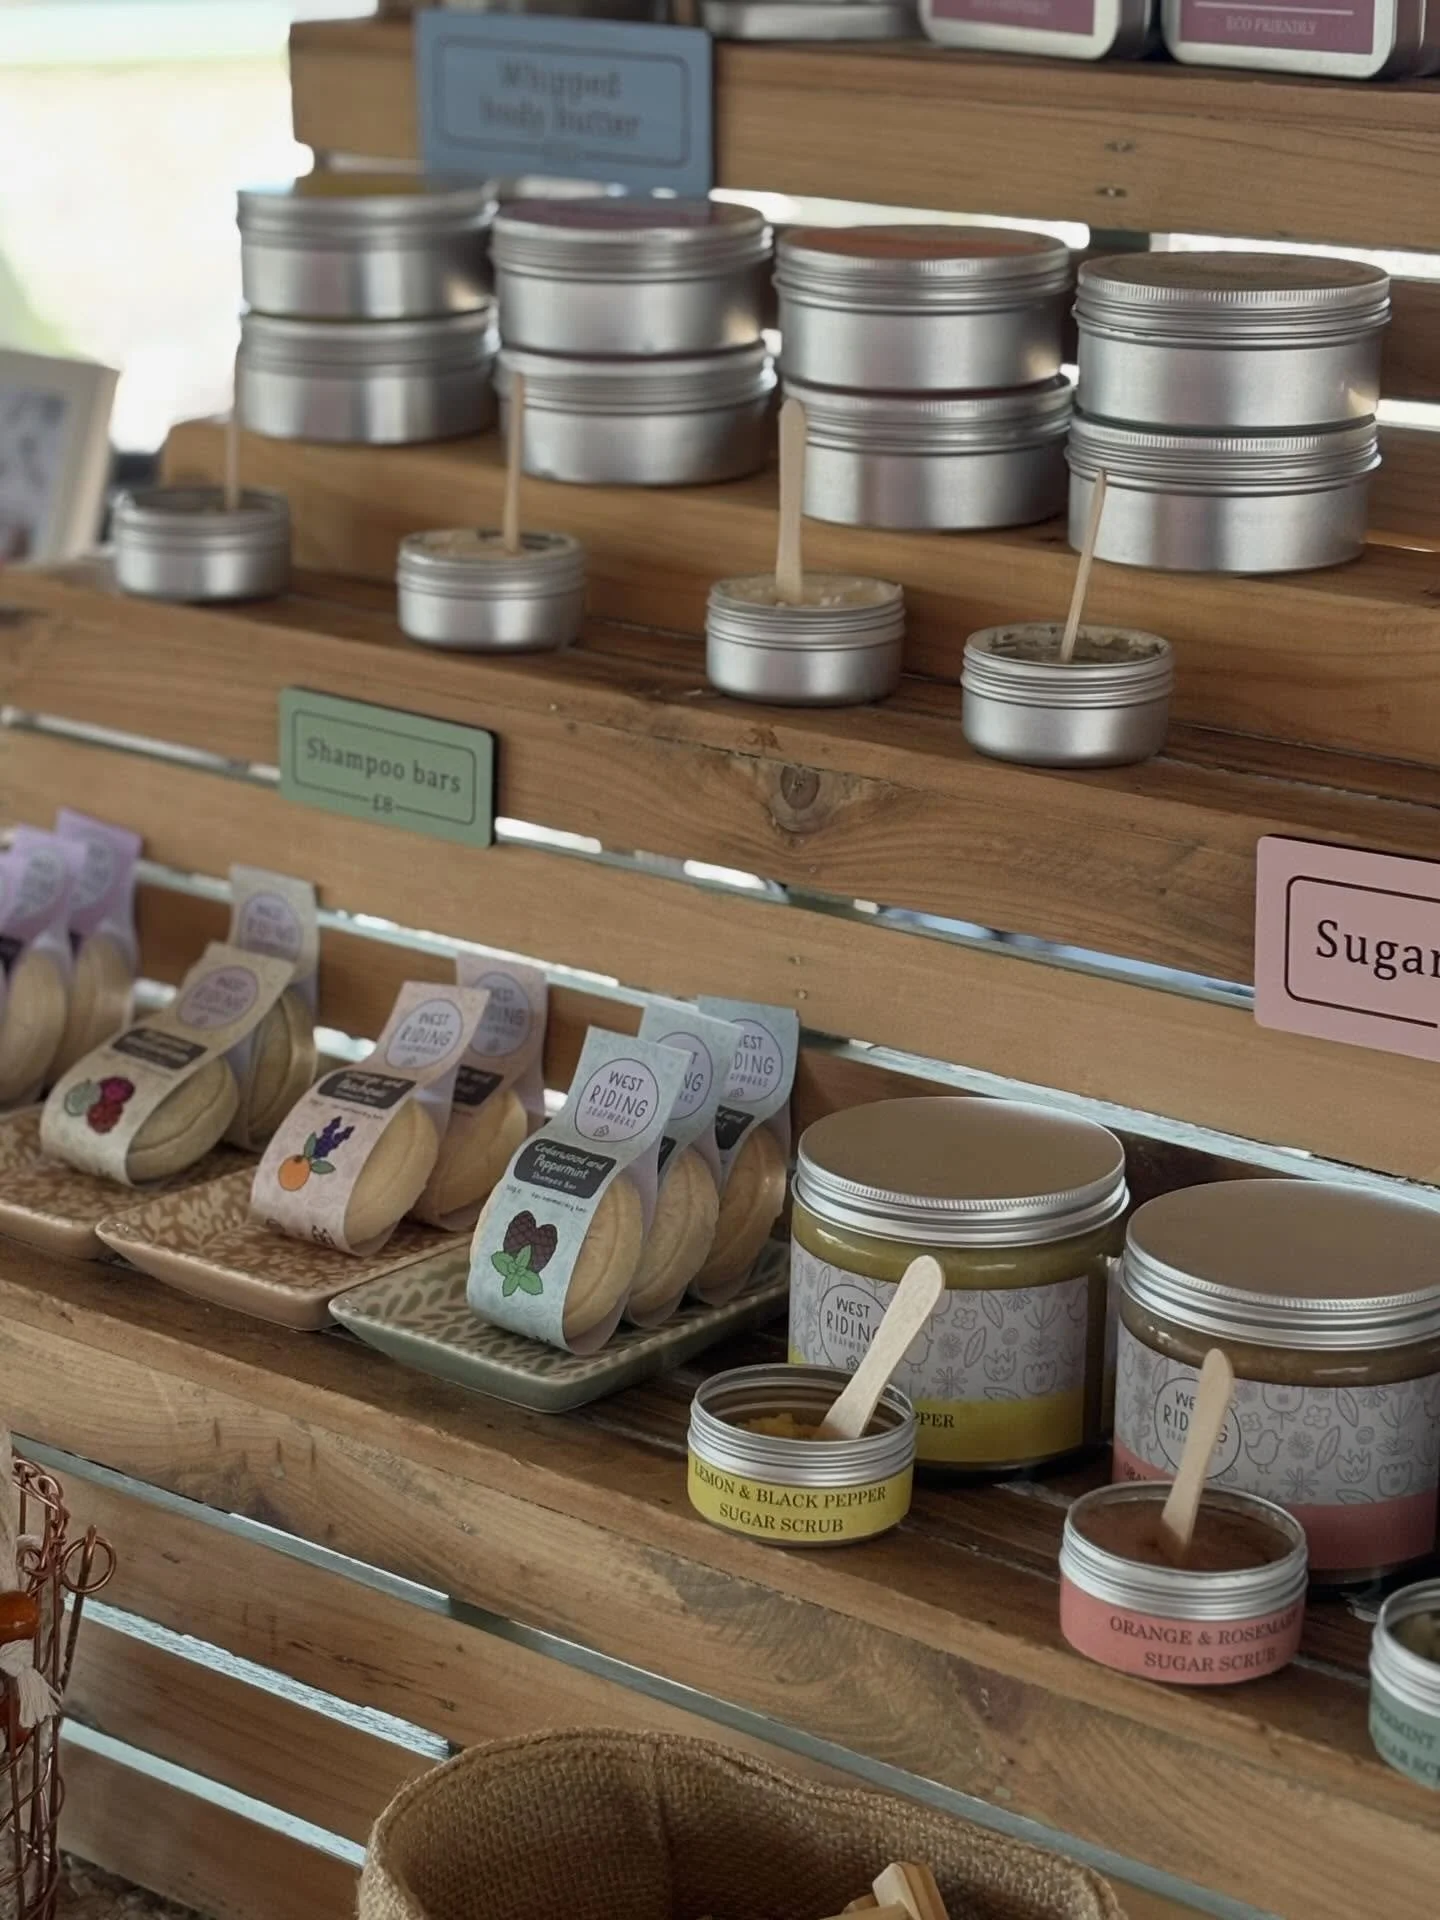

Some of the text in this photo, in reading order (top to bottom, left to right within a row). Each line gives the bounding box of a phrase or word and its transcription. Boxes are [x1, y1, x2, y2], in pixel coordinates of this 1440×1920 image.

[1226, 15, 1317, 37] ECO FRIENDLY
[500, 58, 623, 104] Whipped
[306, 736, 461, 793] Shampoo bars
[400, 1024, 453, 1046] RIDING
[739, 1034, 764, 1050] EST
[734, 1051, 775, 1076] DING
[609, 1070, 645, 1092] WEST
[588, 1084, 649, 1118] RIDING
[534, 1154, 590, 1179] Peppermint
[836, 1295, 871, 1319] WEST
[1175, 1389, 1197, 1411] WE
[694, 1459, 886, 1510] LEMON & BLACK PEPPER
[719, 1502, 844, 1534] SUGAR SCRUB
[1109, 1615, 1193, 1646] ORANGE
[1197, 1629, 1212, 1645] &
[1143, 1646, 1277, 1673] SUGAR SCRUB
